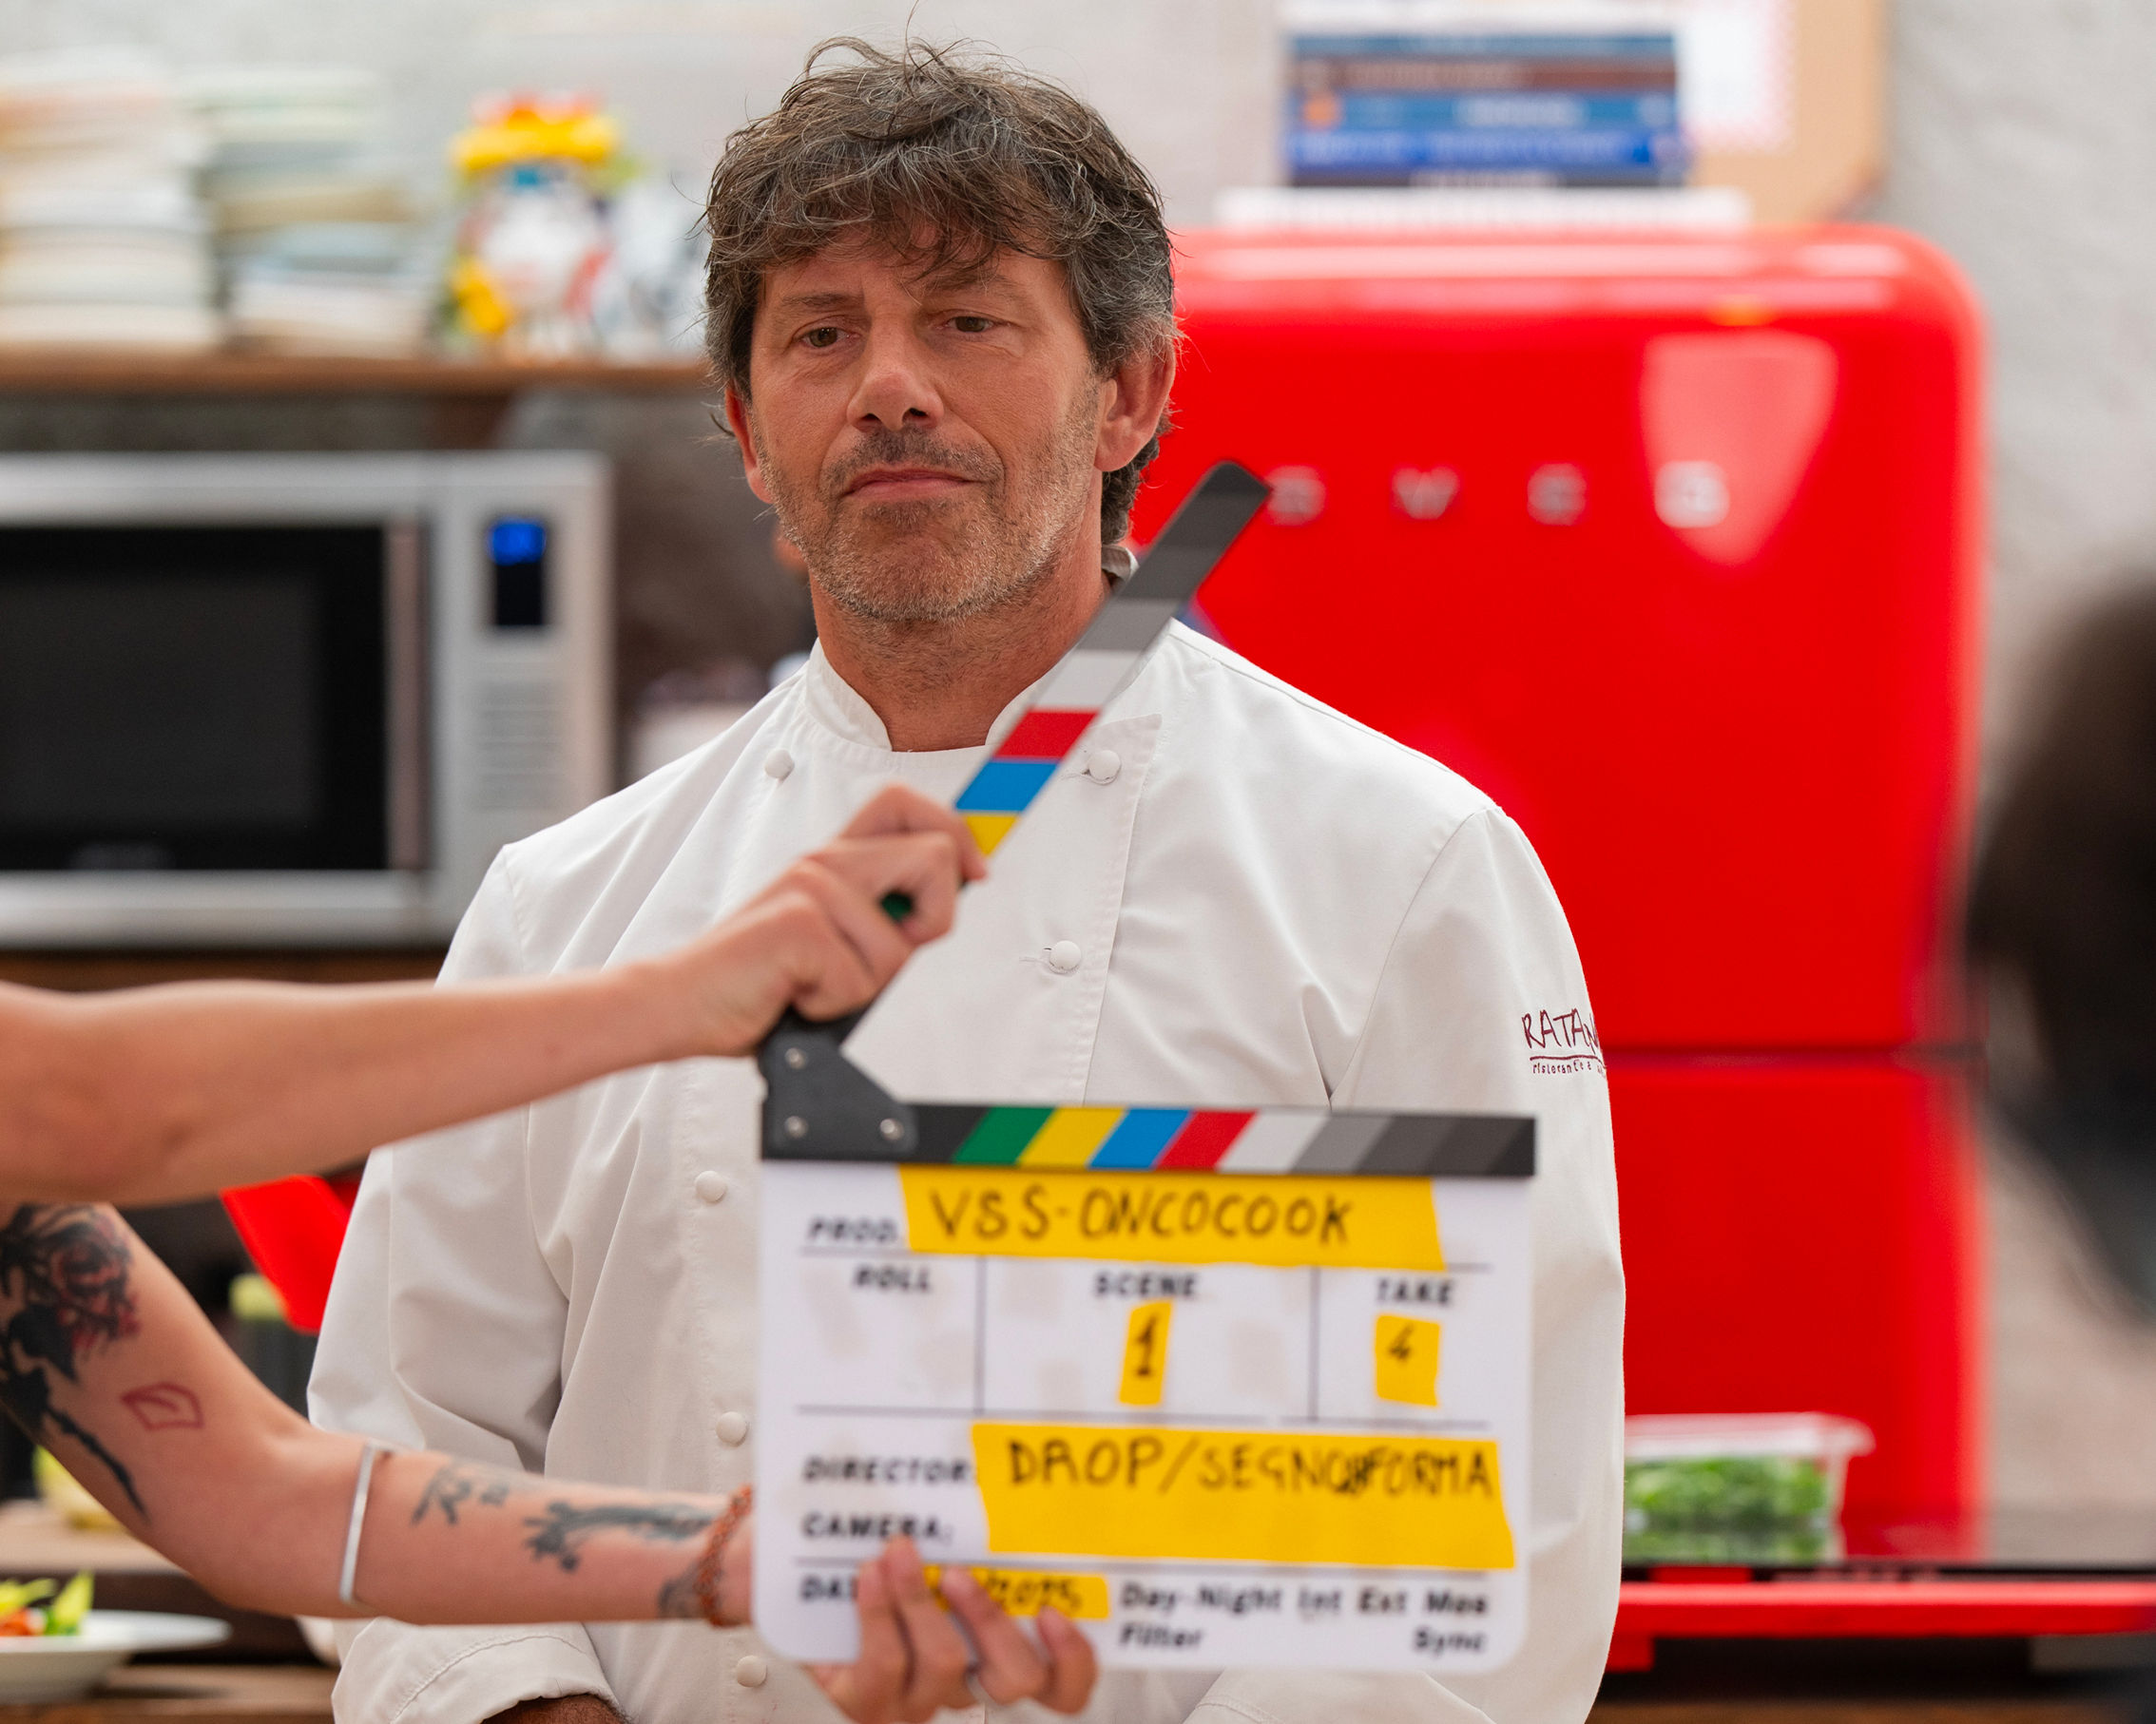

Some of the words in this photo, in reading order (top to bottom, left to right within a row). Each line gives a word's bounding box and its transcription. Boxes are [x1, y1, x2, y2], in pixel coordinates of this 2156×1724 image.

[854, 1265, 932, 1293] ROLL
[1093, 1272, 1201, 1298] SCENE
[1376, 1278, 1456, 1306] TAKE
[1133, 1311, 1162, 1379] 1
[1384, 1323, 1415, 1363] 4
[1120, 1620, 1203, 1649] Filter
